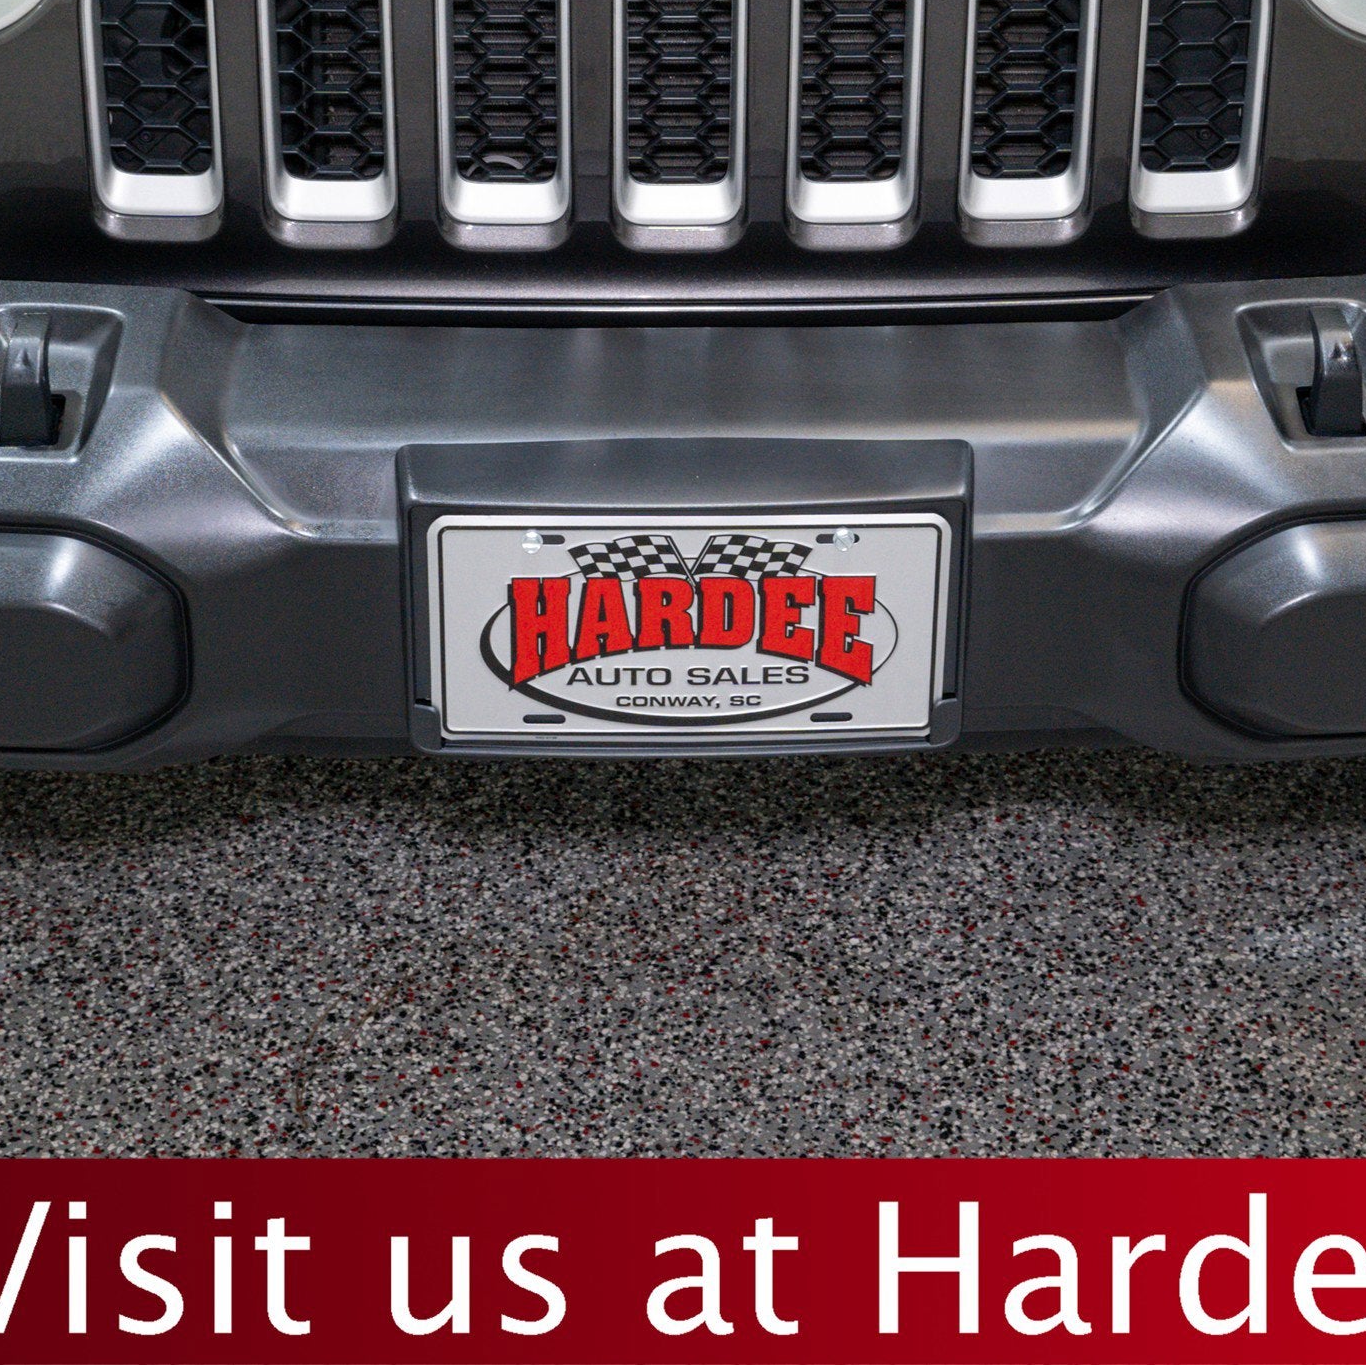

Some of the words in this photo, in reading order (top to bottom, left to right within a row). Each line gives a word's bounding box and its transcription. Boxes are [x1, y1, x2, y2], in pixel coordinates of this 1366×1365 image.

[507, 575, 877, 688] HARDEE
[566, 666, 673, 686] AUTO
[686, 665, 811, 686] SALES
[615, 695, 721, 710] CONWAY,
[729, 695, 762, 707] SC
